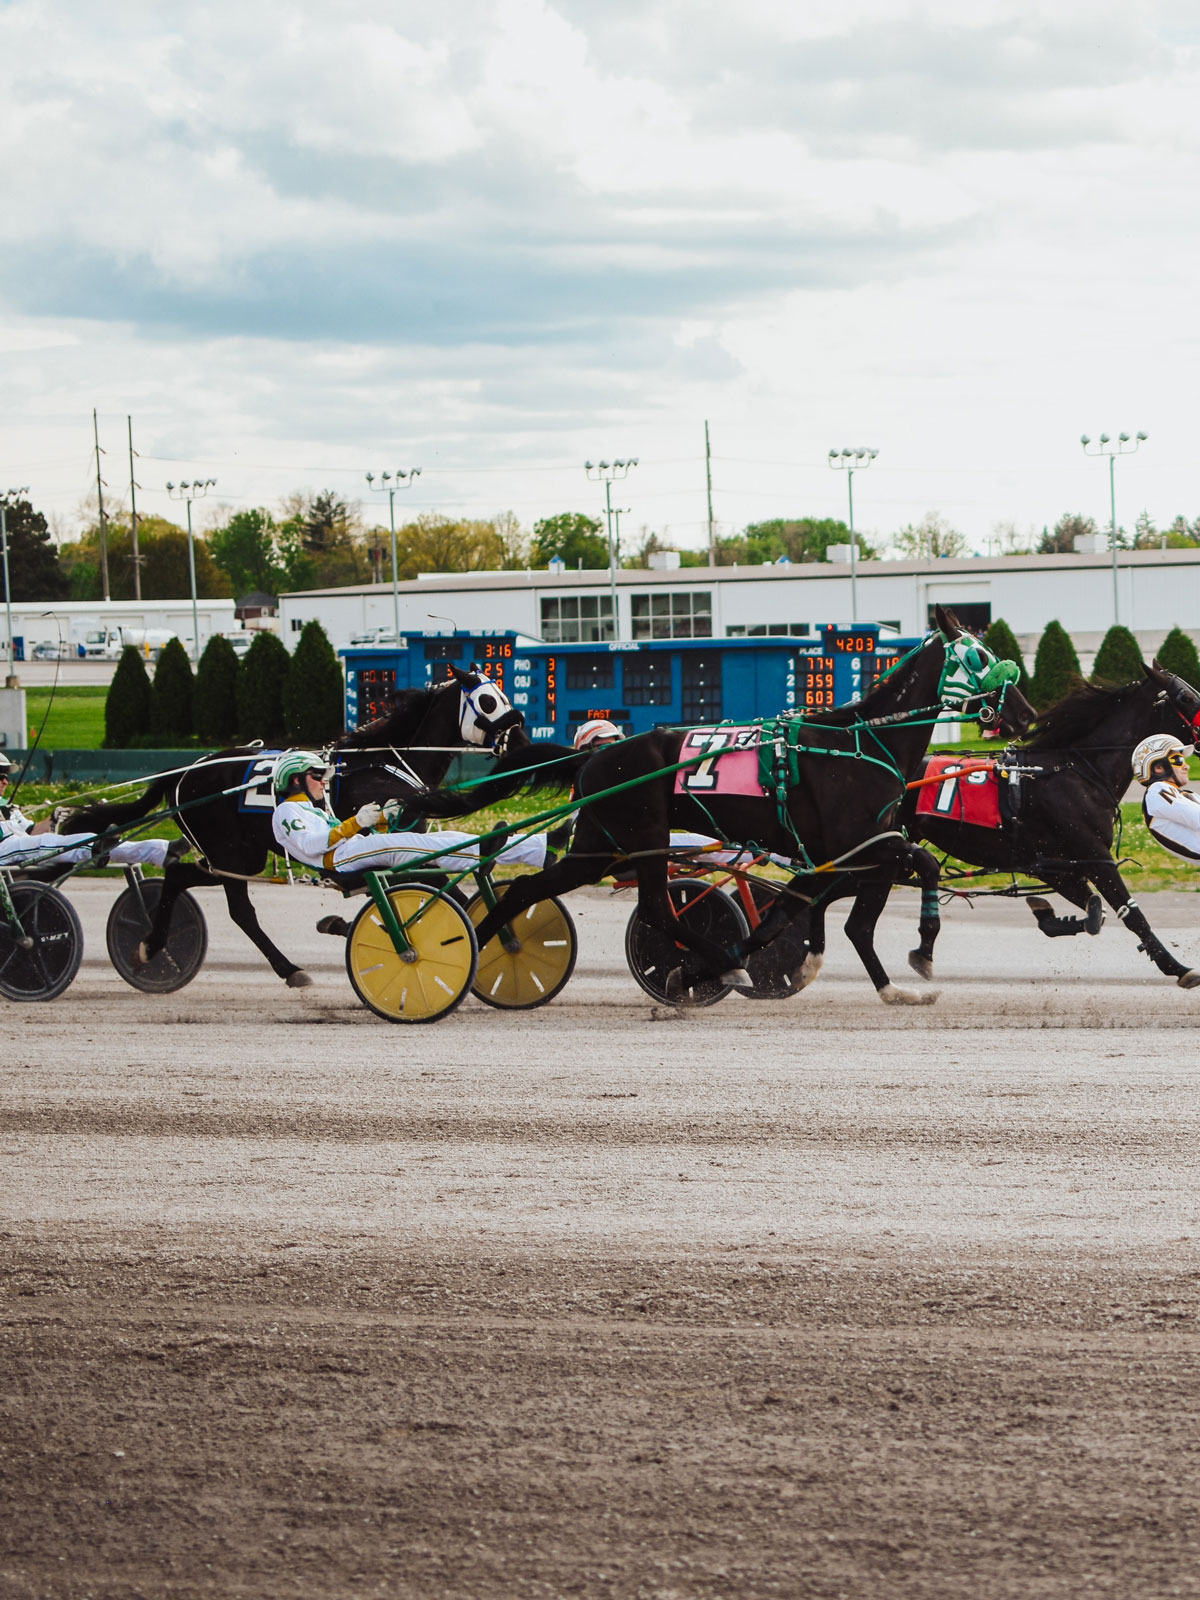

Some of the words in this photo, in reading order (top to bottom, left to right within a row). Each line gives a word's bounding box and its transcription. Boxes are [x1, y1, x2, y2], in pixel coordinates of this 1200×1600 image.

[608, 642, 641, 651] OFFICIAL
[836, 637, 875, 652] 4203
[486, 644, 511, 658] 3:16
[875, 647, 898, 655] SHOW
[424, 663, 431, 675] 1
[548, 658, 556, 671] 3
[787, 659, 794, 670] 1
[806, 657, 834, 671] 774
[850, 658, 861, 670] 6
[347, 671, 355, 683] F
[513, 676, 531, 688] OBJ
[547, 675, 556, 688] 5
[786, 675, 796, 687] 2
[806, 674, 834, 688] 359
[851, 675, 861, 687] 7
[547, 692, 556, 705] 4
[786, 692, 796, 704] 3
[805, 691, 834, 705] 603
[851, 691, 861, 702] 8
[587, 709, 612, 719] FAST
[532, 727, 555, 738] MTP
[684, 732, 732, 789] 7
[281, 818, 306, 837] JC
